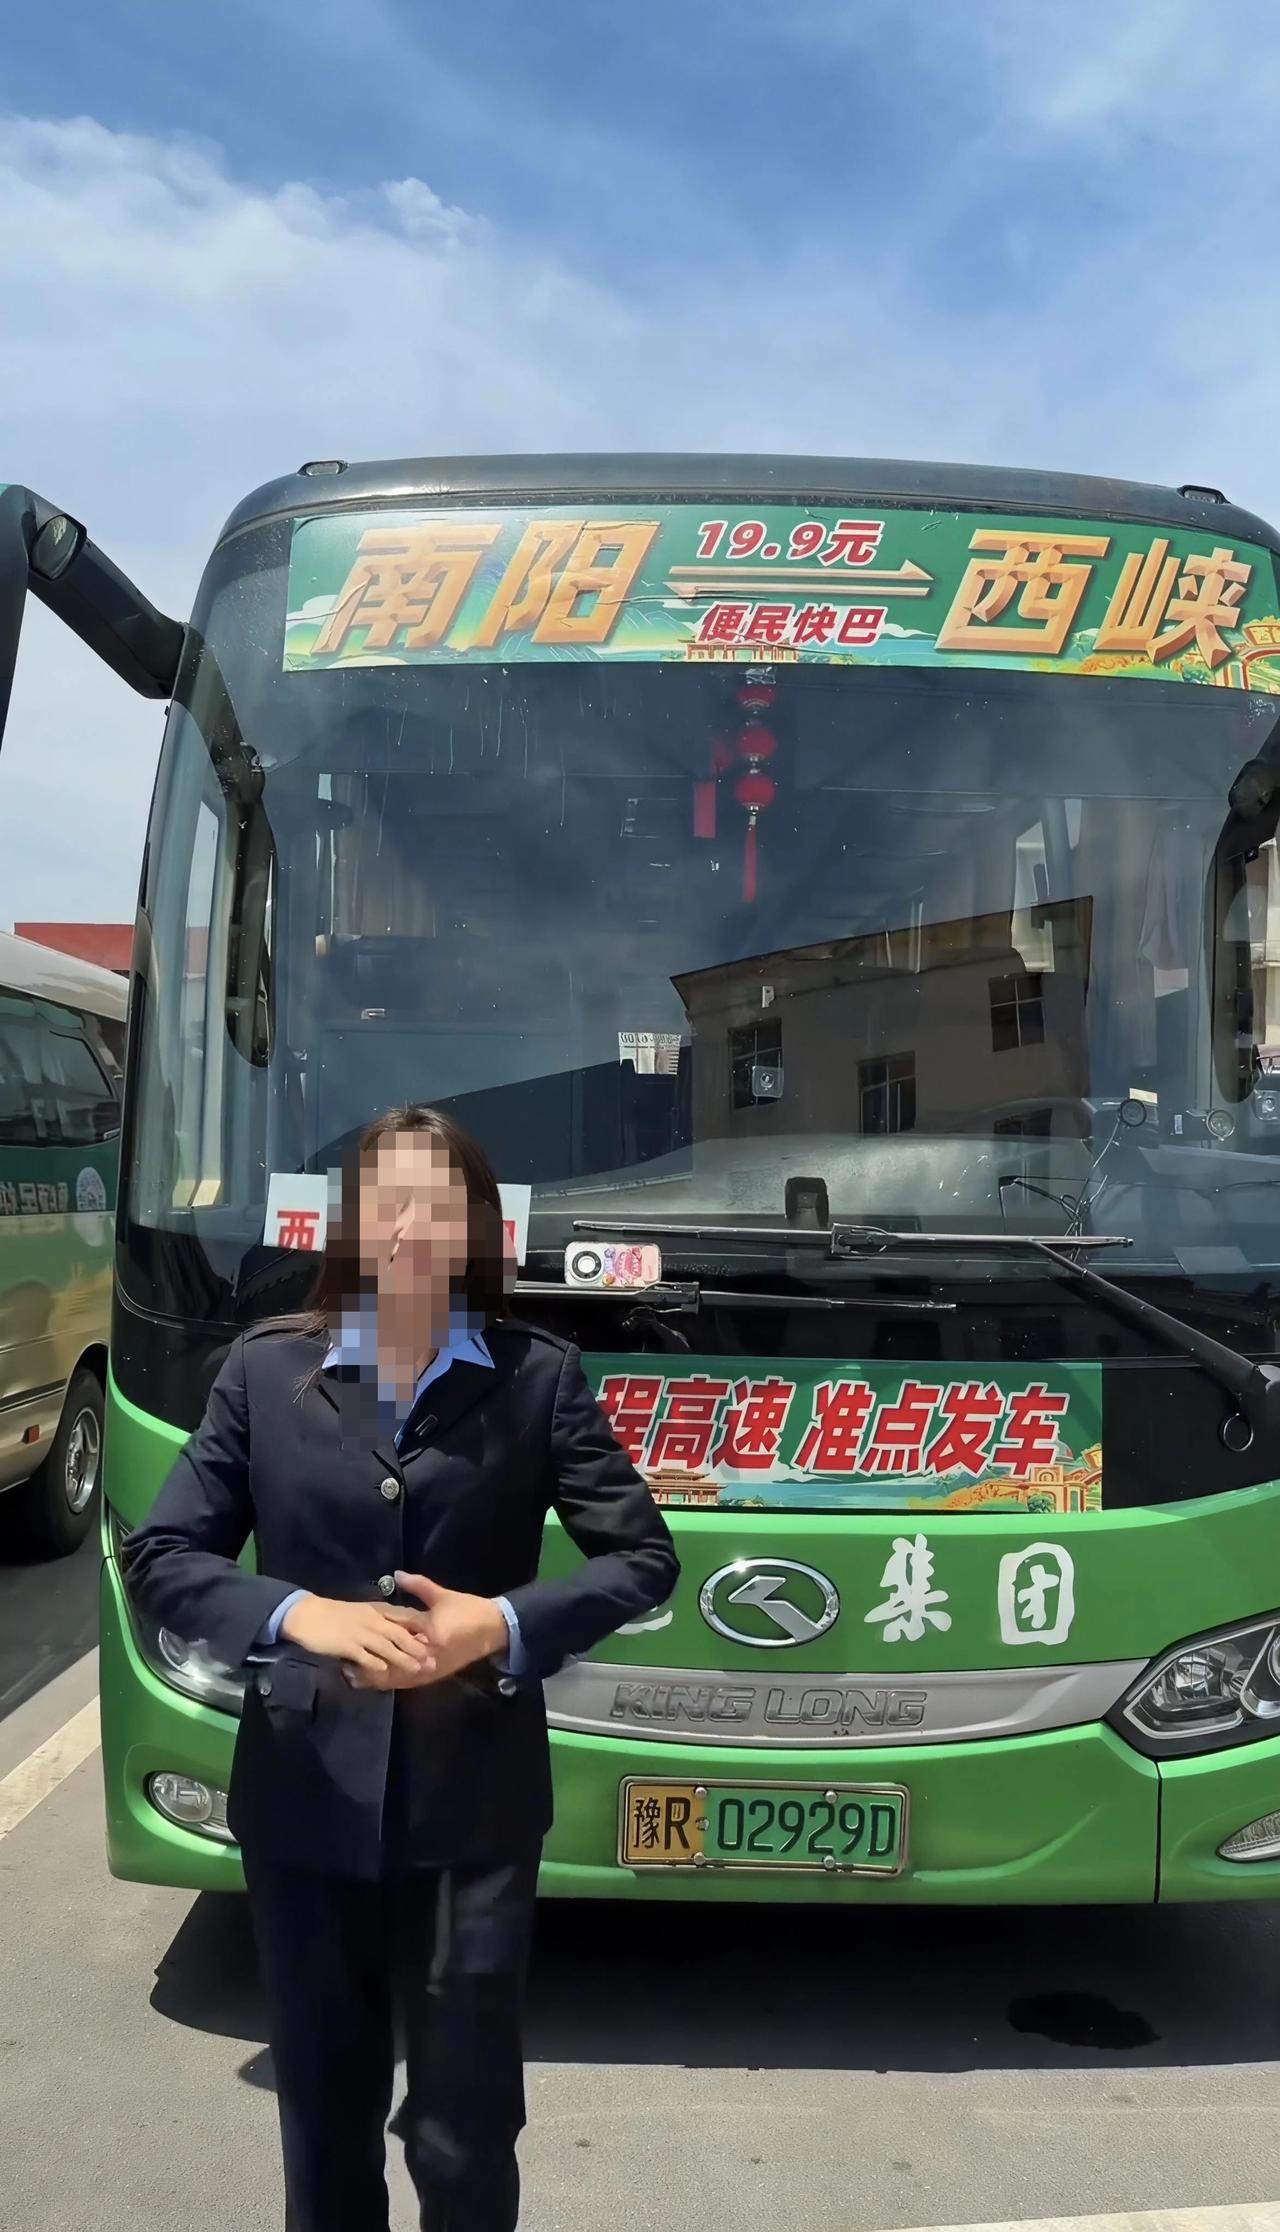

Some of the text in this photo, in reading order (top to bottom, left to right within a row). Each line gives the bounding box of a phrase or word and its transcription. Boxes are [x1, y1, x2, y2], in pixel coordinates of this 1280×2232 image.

[697, 519, 884, 566] 19.9元
[311, 519, 1252, 670] 南阳 西峡
[698, 601, 885, 647] 便民快巴
[796, 1378, 1069, 1478] 准点发车
[864, 1533, 1075, 1645] 集团
[609, 1682, 928, 1726] KING LONG
